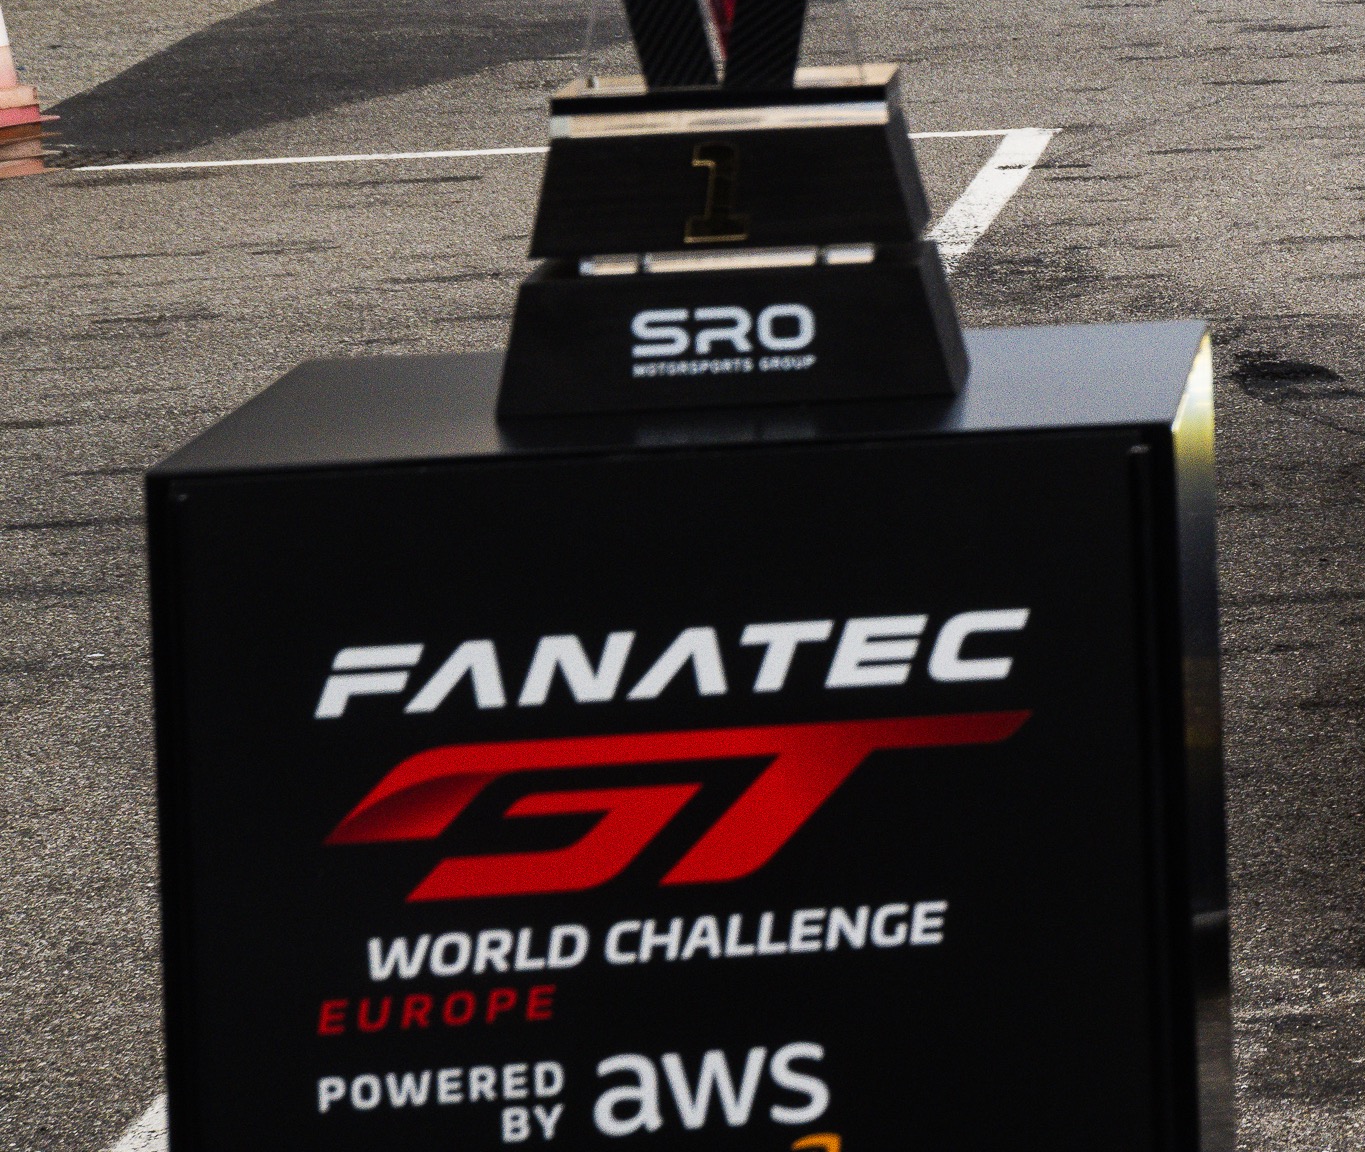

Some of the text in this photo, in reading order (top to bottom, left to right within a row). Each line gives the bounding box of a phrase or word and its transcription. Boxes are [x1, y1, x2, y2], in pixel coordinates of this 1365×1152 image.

[631, 304, 815, 358] SRO
[632, 355, 817, 378] MOTORSPORTS GROUP
[314, 608, 1030, 720] FANATEC
[322, 709, 1034, 904] GT
[367, 900, 948, 981] WORLD CHALLENGE
[316, 984, 558, 1036] EUROPE
[317, 1041, 831, 1138] POWERED aws
[501, 1103, 564, 1143] BY
